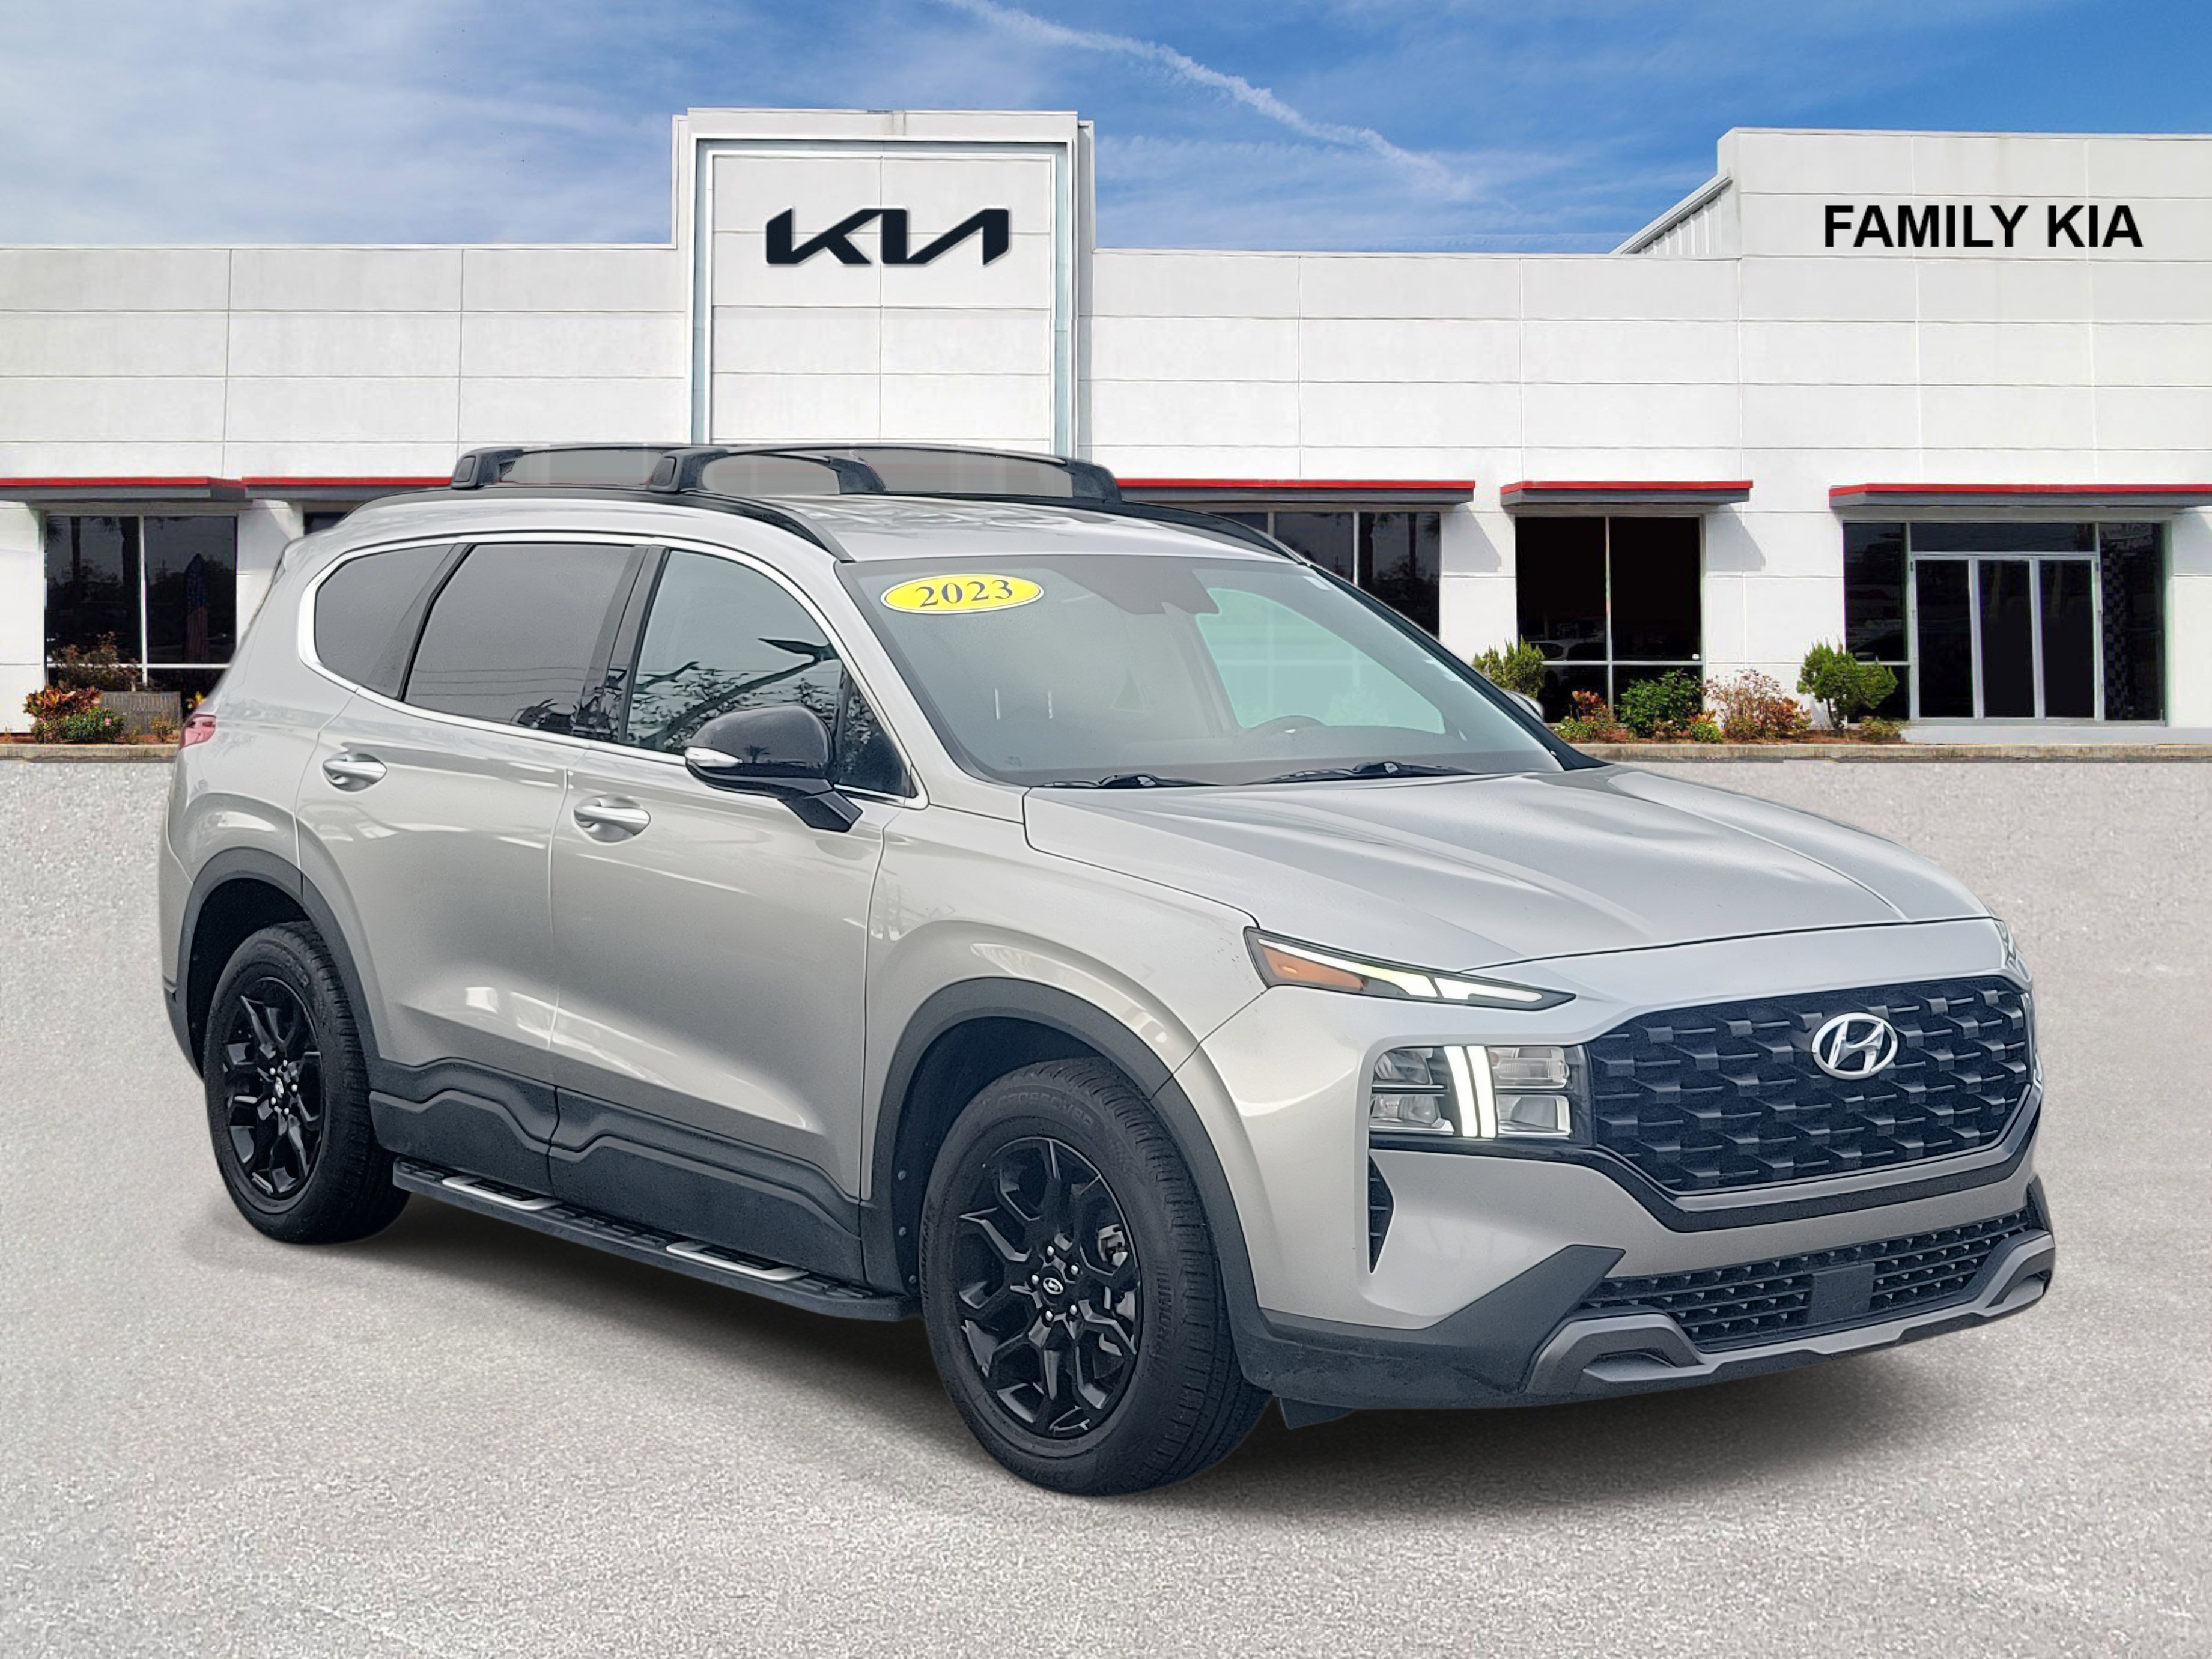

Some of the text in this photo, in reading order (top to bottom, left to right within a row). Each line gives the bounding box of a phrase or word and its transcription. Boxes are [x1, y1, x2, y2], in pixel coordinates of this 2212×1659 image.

[766, 208, 1009, 265] KIA
[1825, 205, 2144, 247] FAMILY KIA
[915, 580, 1013, 608] 2023
